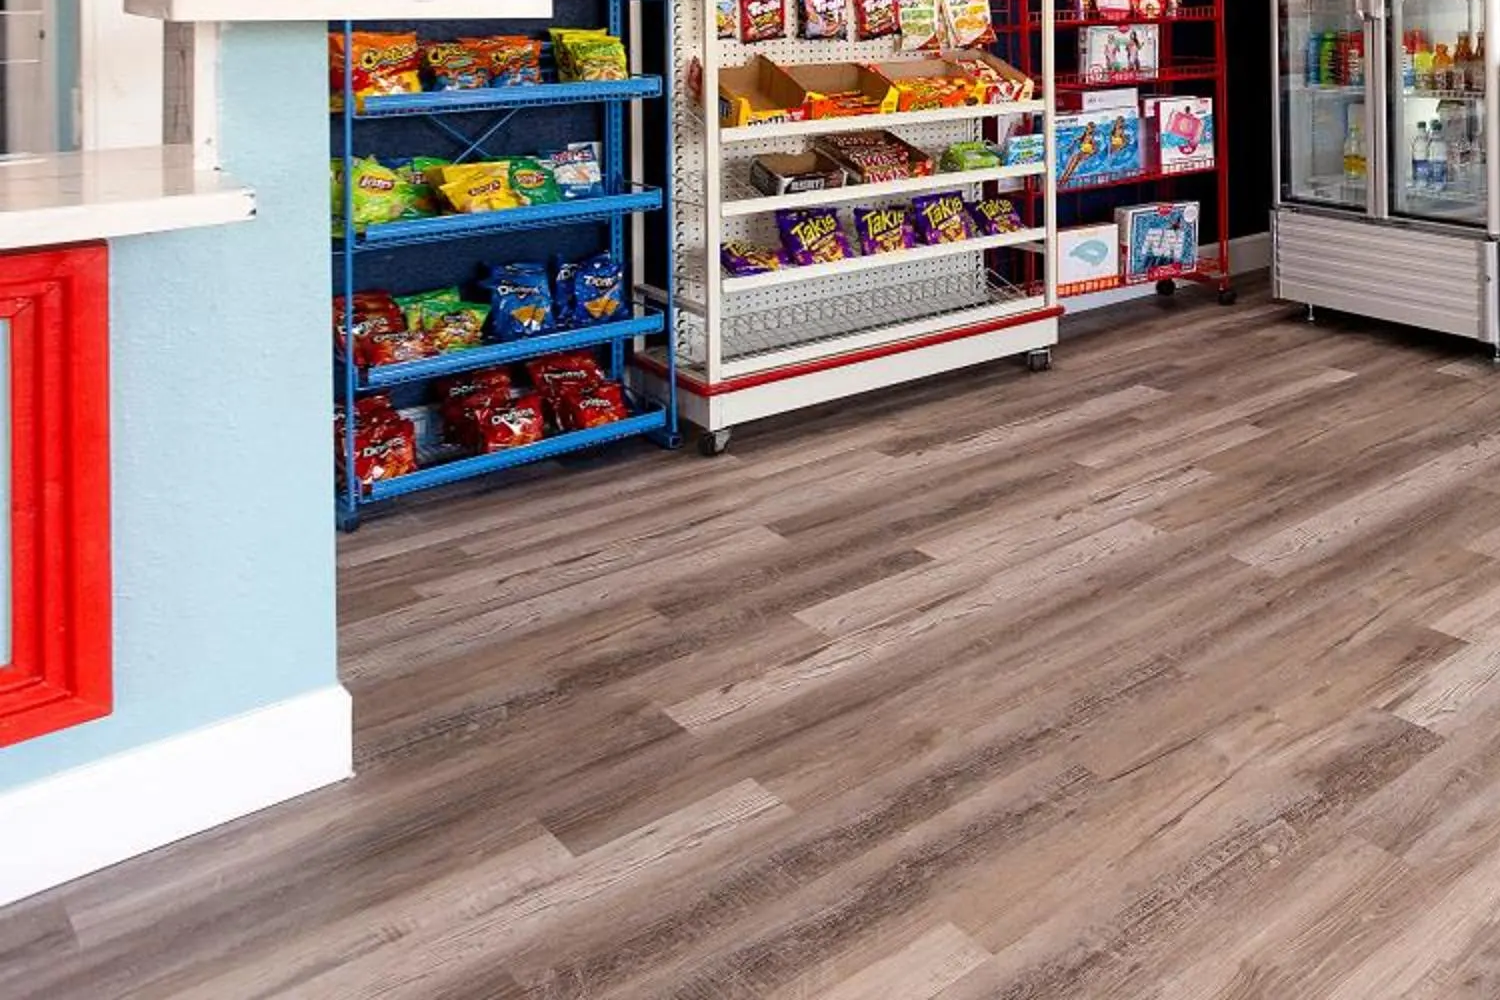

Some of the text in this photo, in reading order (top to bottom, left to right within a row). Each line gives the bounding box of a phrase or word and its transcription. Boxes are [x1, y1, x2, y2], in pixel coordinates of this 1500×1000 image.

[862, 208, 904, 240] Takis
[922, 197, 963, 229] Takis
[976, 200, 1013, 220] Takis
[790, 213, 837, 251] Takis
